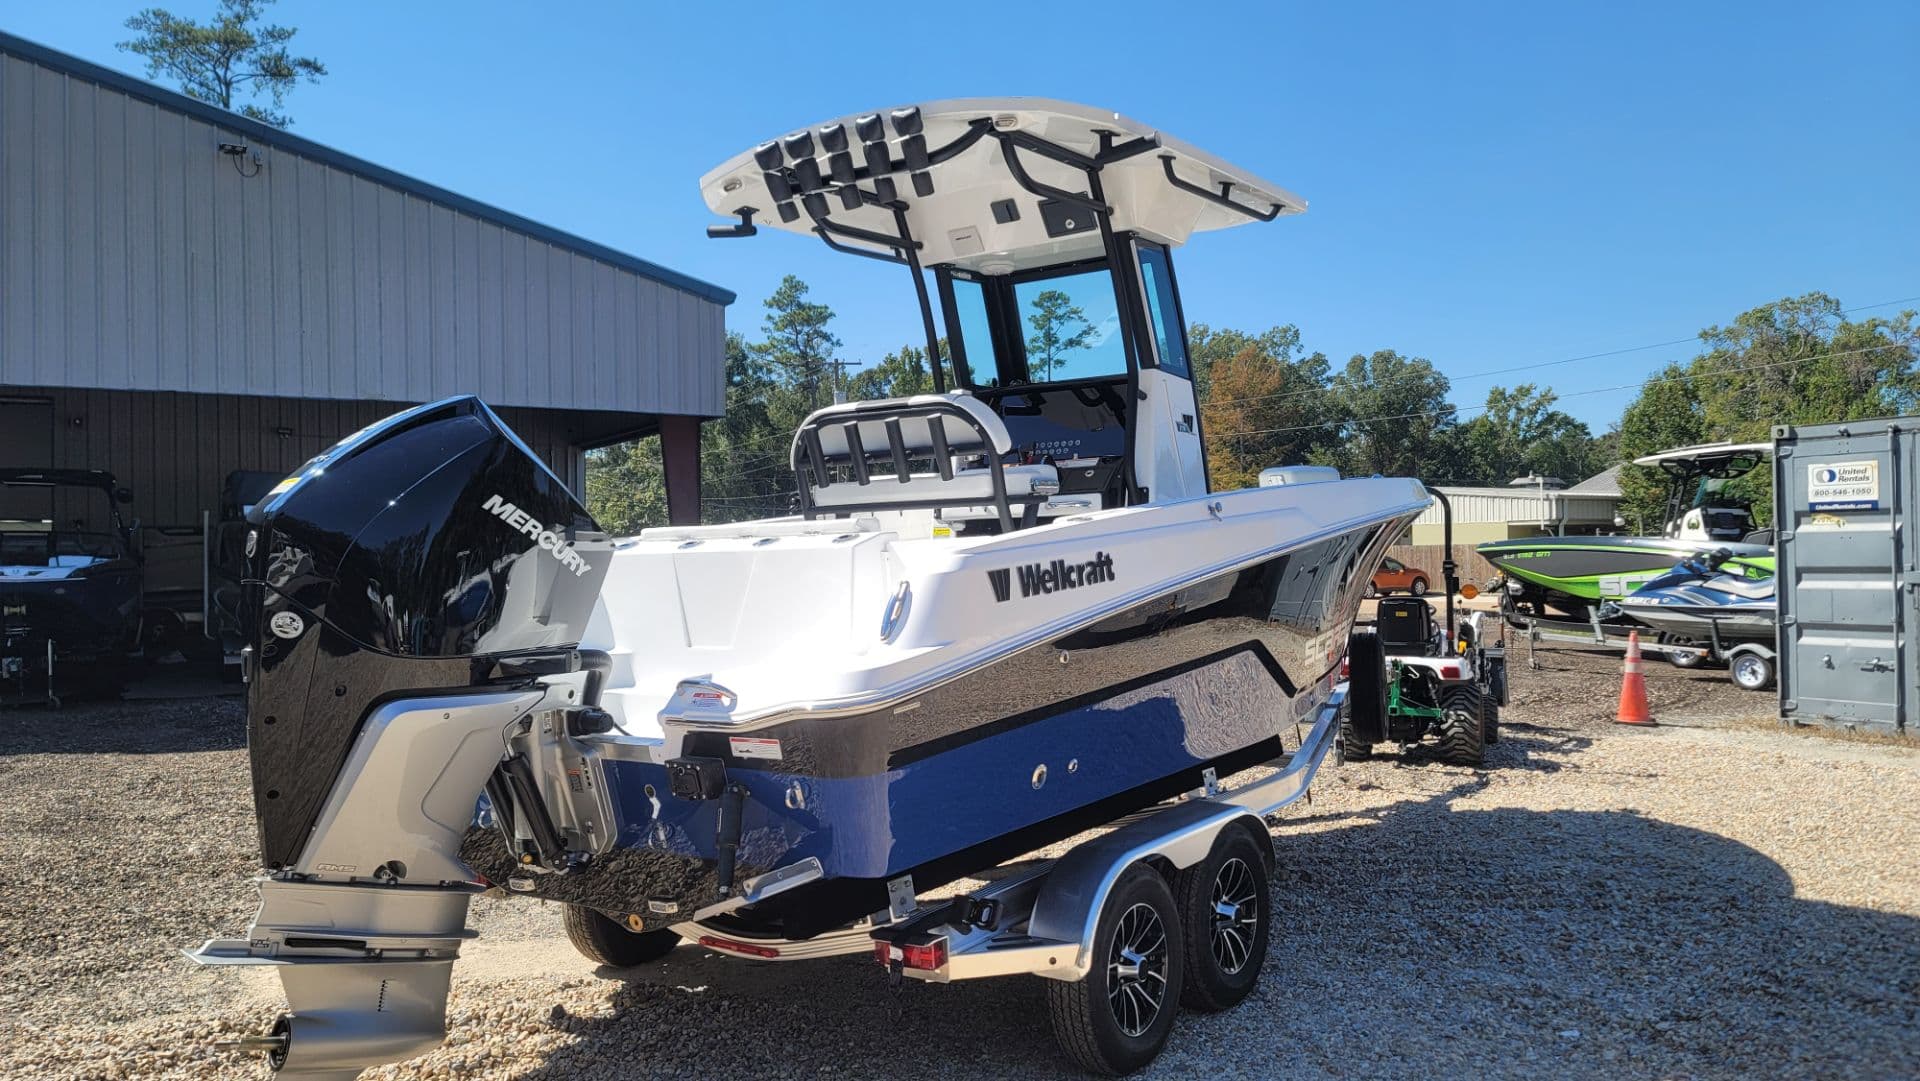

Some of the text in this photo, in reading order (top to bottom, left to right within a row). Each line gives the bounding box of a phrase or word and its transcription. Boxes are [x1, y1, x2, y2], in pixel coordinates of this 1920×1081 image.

[1838, 467, 1867, 475] United
[1838, 475, 1870, 483] Rentals
[481, 494, 592, 577] MERCURY
[1016, 551, 1115, 598] Wellcraft
